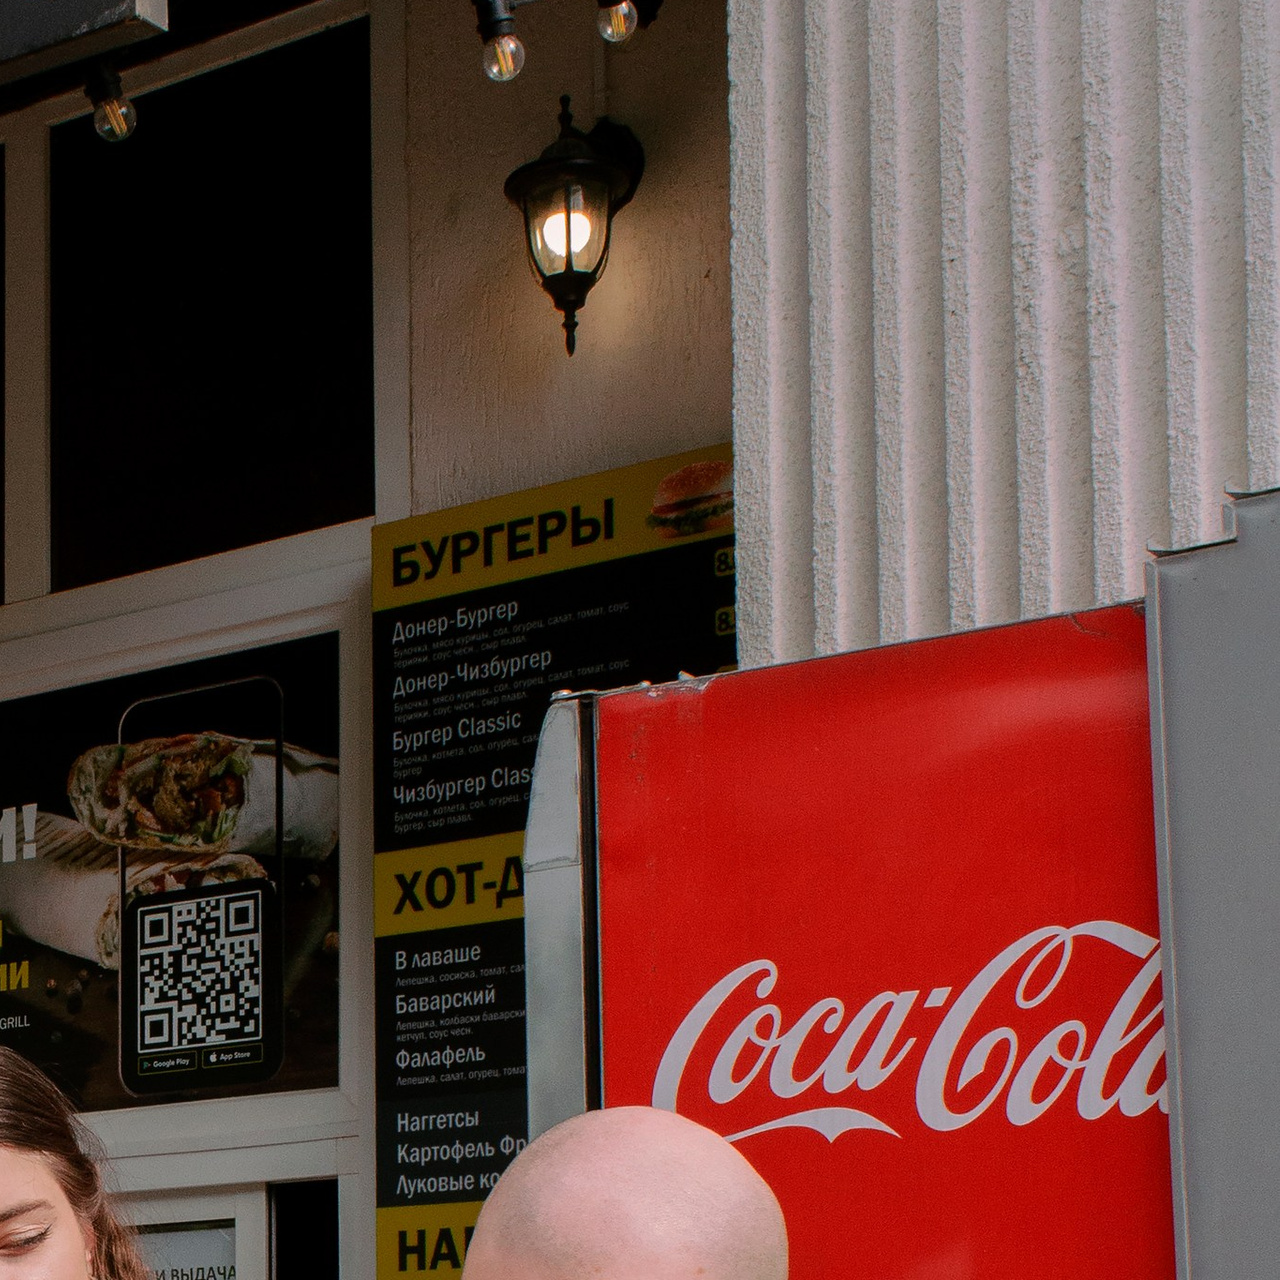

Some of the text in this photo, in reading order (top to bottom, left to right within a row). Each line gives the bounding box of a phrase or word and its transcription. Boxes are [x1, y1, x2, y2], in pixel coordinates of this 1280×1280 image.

[393, 498, 614, 587] БУРГЕРЫ
[392, 599, 518, 645] Донер-Бургер
[392, 648, 551, 699] Донер-Чизбургер
[392, 708, 520, 754] Бургер Classic
[393, 773, 484, 809] Чизбургер
[393, 856, 524, 915] ХОТ-Д
[395, 944, 480, 970] В лаваше
[509, 962, 524, 974] сал
[395, 983, 495, 1018] Баварский
[439, 1012, 479, 1027] колбаски
[482, 1008, 524, 1022] баварски
[429, 1029, 448, 1039] соус
[176, 1059, 190, 1067] Play
[220, 1053, 233, 1062] App
[395, 1044, 485, 1073] Фалафель
[502, 1065, 524, 1077] тома
[397, 1110, 478, 1132] Наггетсы
[397, 1134, 526, 1167] Картофель Фр
[396, 1173, 474, 1198] Луковые
